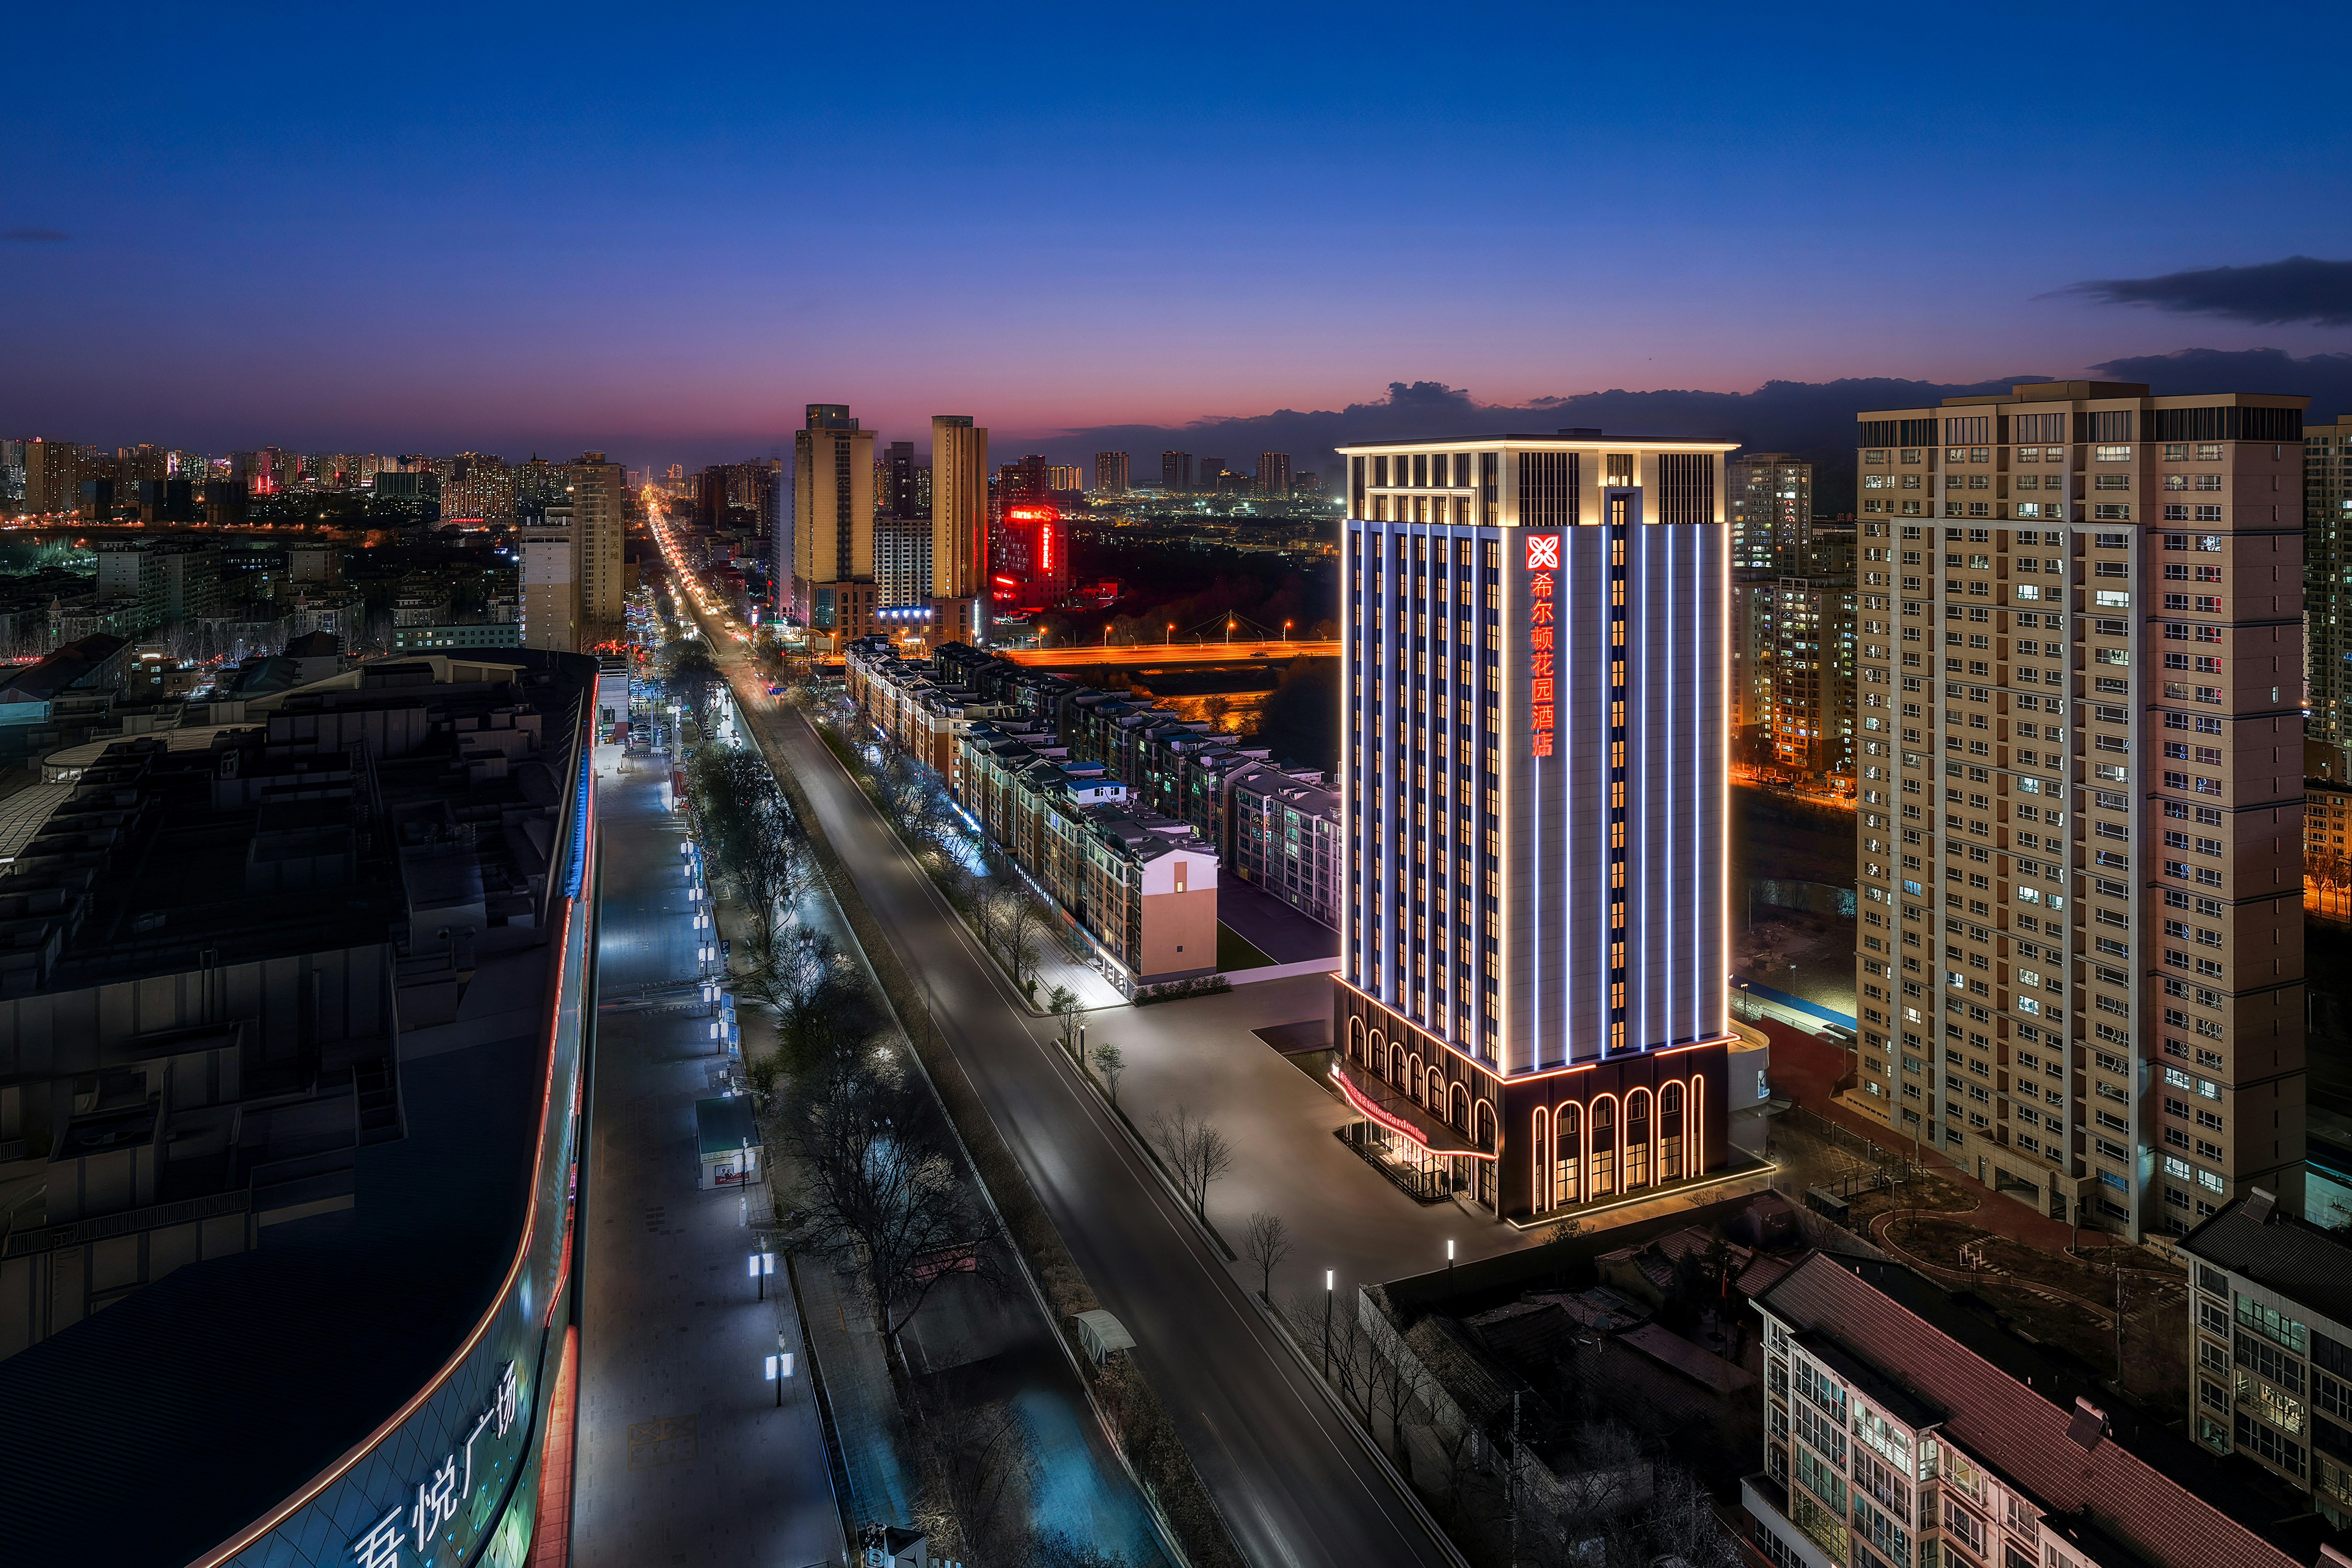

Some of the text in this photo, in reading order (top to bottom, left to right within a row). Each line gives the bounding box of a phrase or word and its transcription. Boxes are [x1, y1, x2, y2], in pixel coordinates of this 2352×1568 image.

[1531, 572, 1554, 757] 希尔顿花园酒店
[1367, 1101, 1427, 1143] Hilton Garden Inn
[354, 1359, 516, 1568] 吾悦广场
